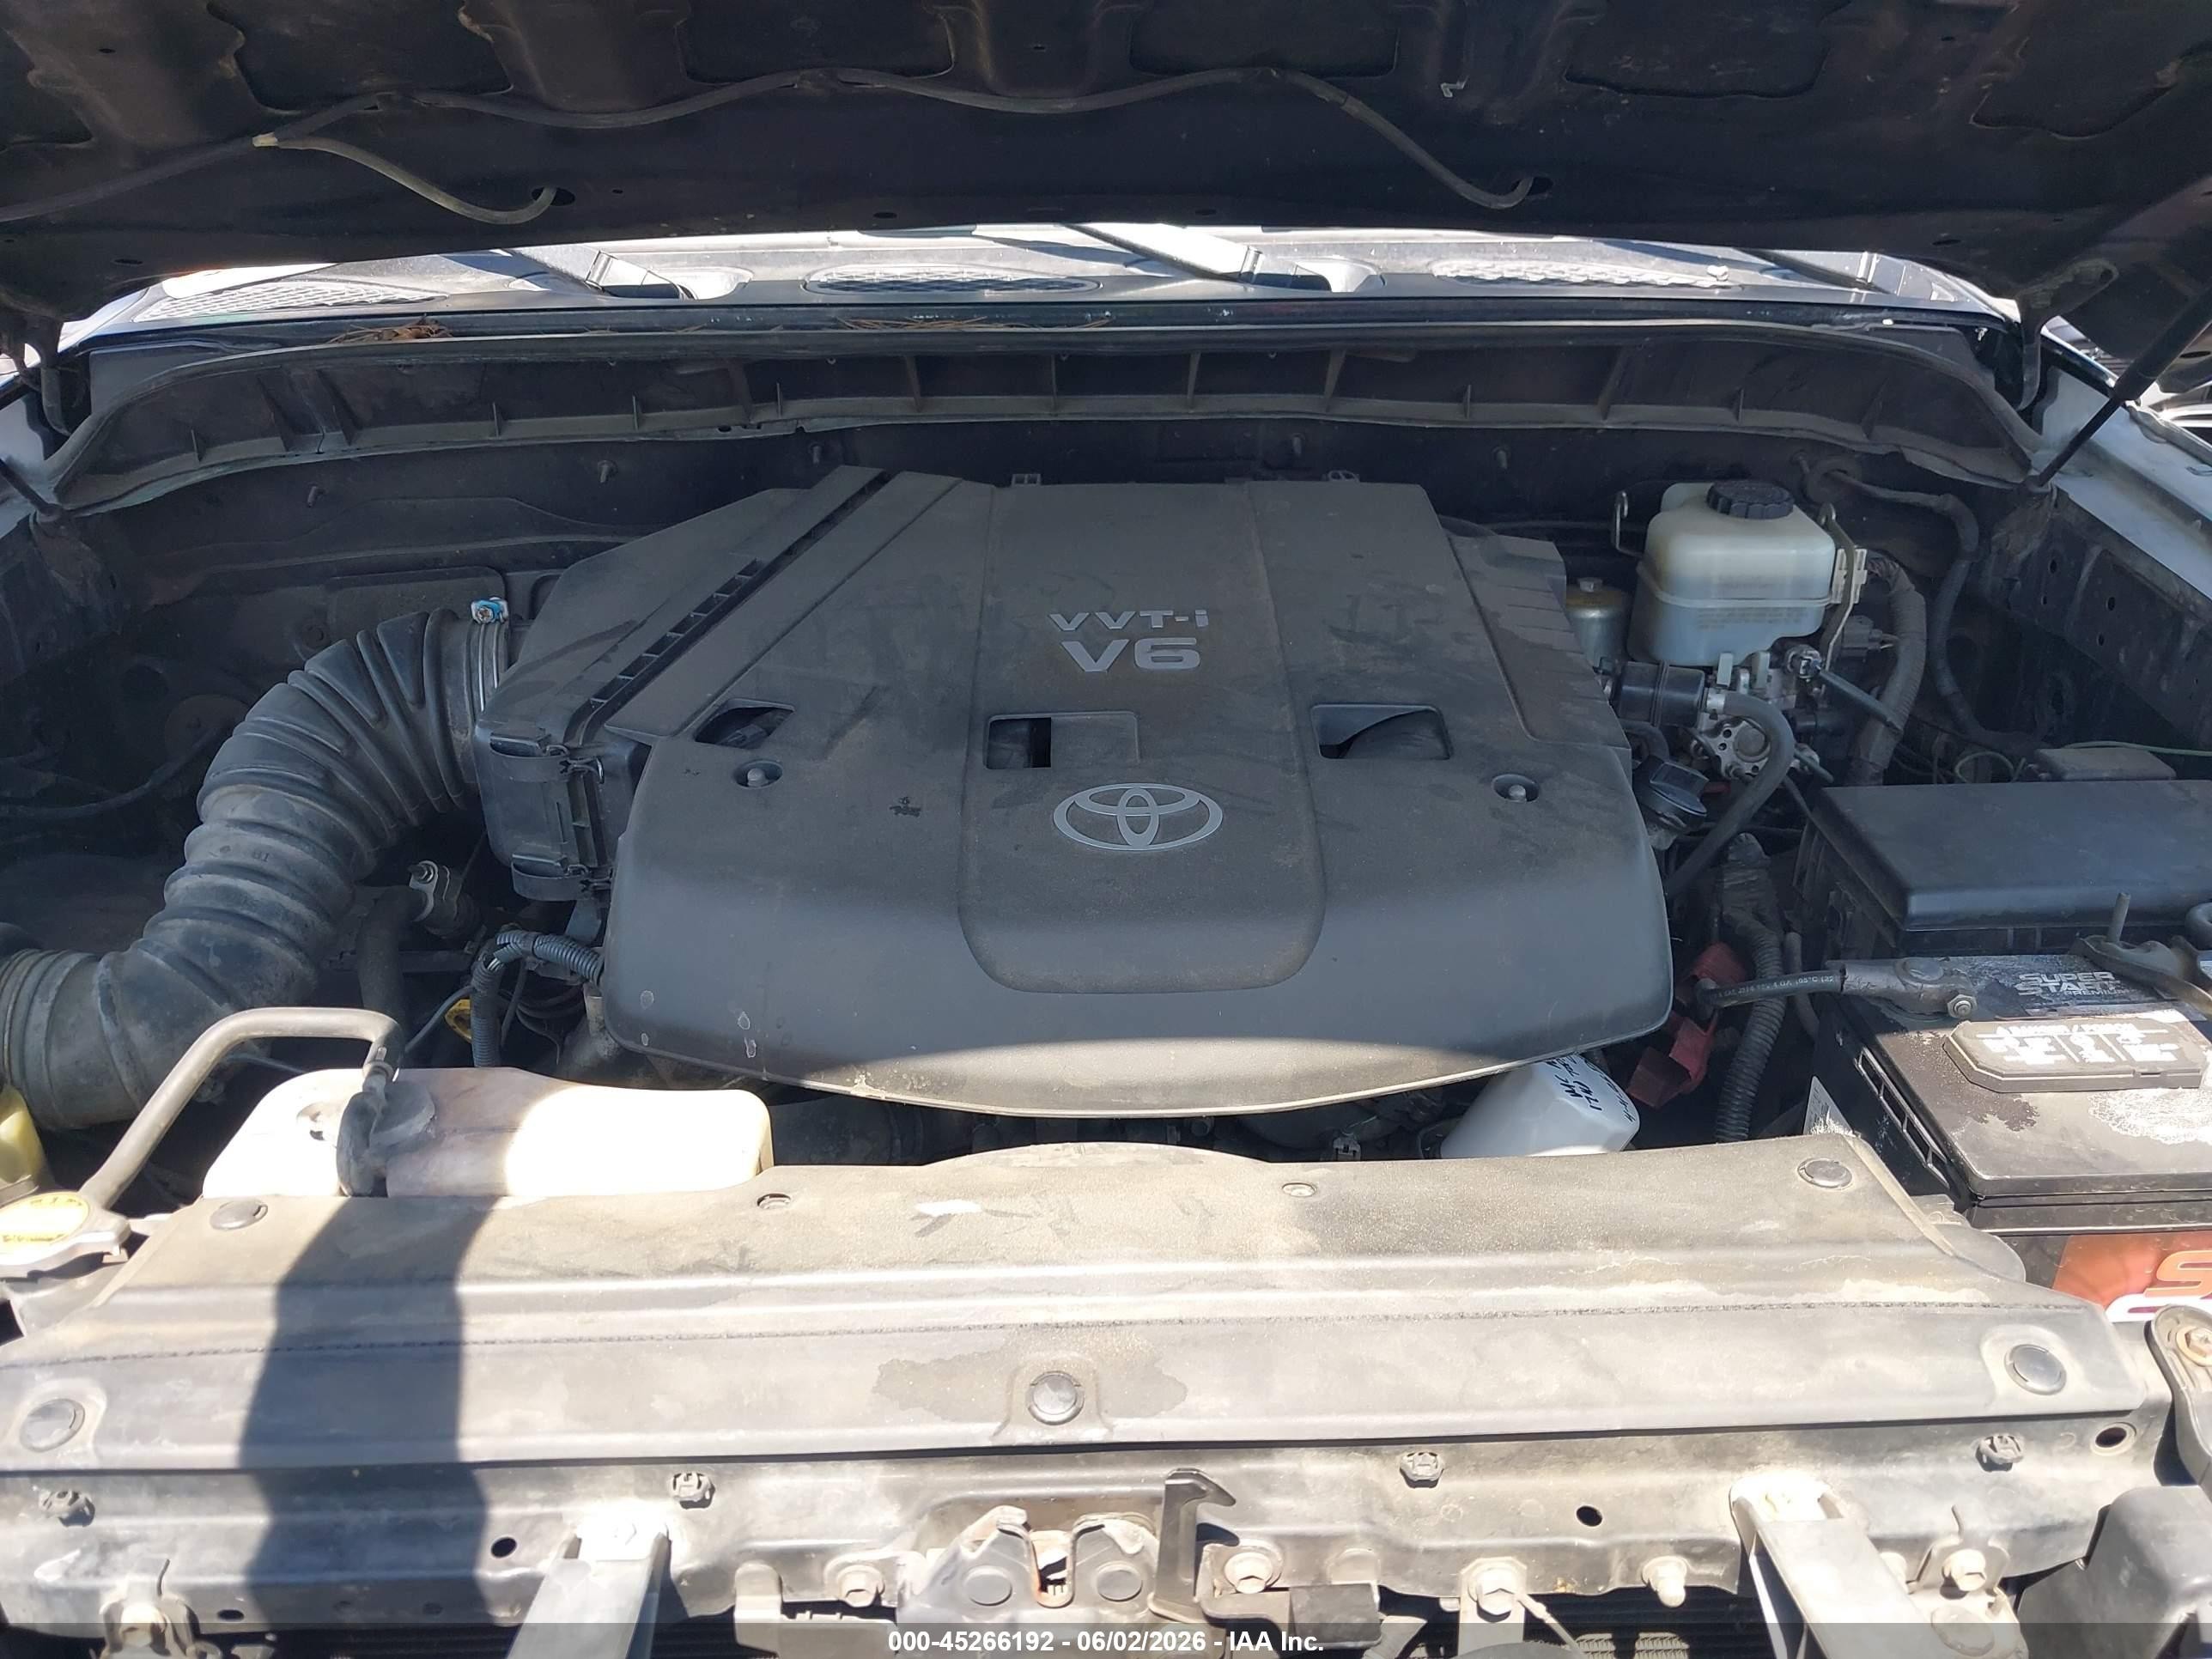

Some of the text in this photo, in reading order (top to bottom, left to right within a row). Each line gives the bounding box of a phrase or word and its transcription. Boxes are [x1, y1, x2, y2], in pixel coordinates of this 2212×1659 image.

[1060, 637, 1200, 672] V6
[2019, 971, 2115, 983] SUPER
[2014, 980, 2122, 995] START
